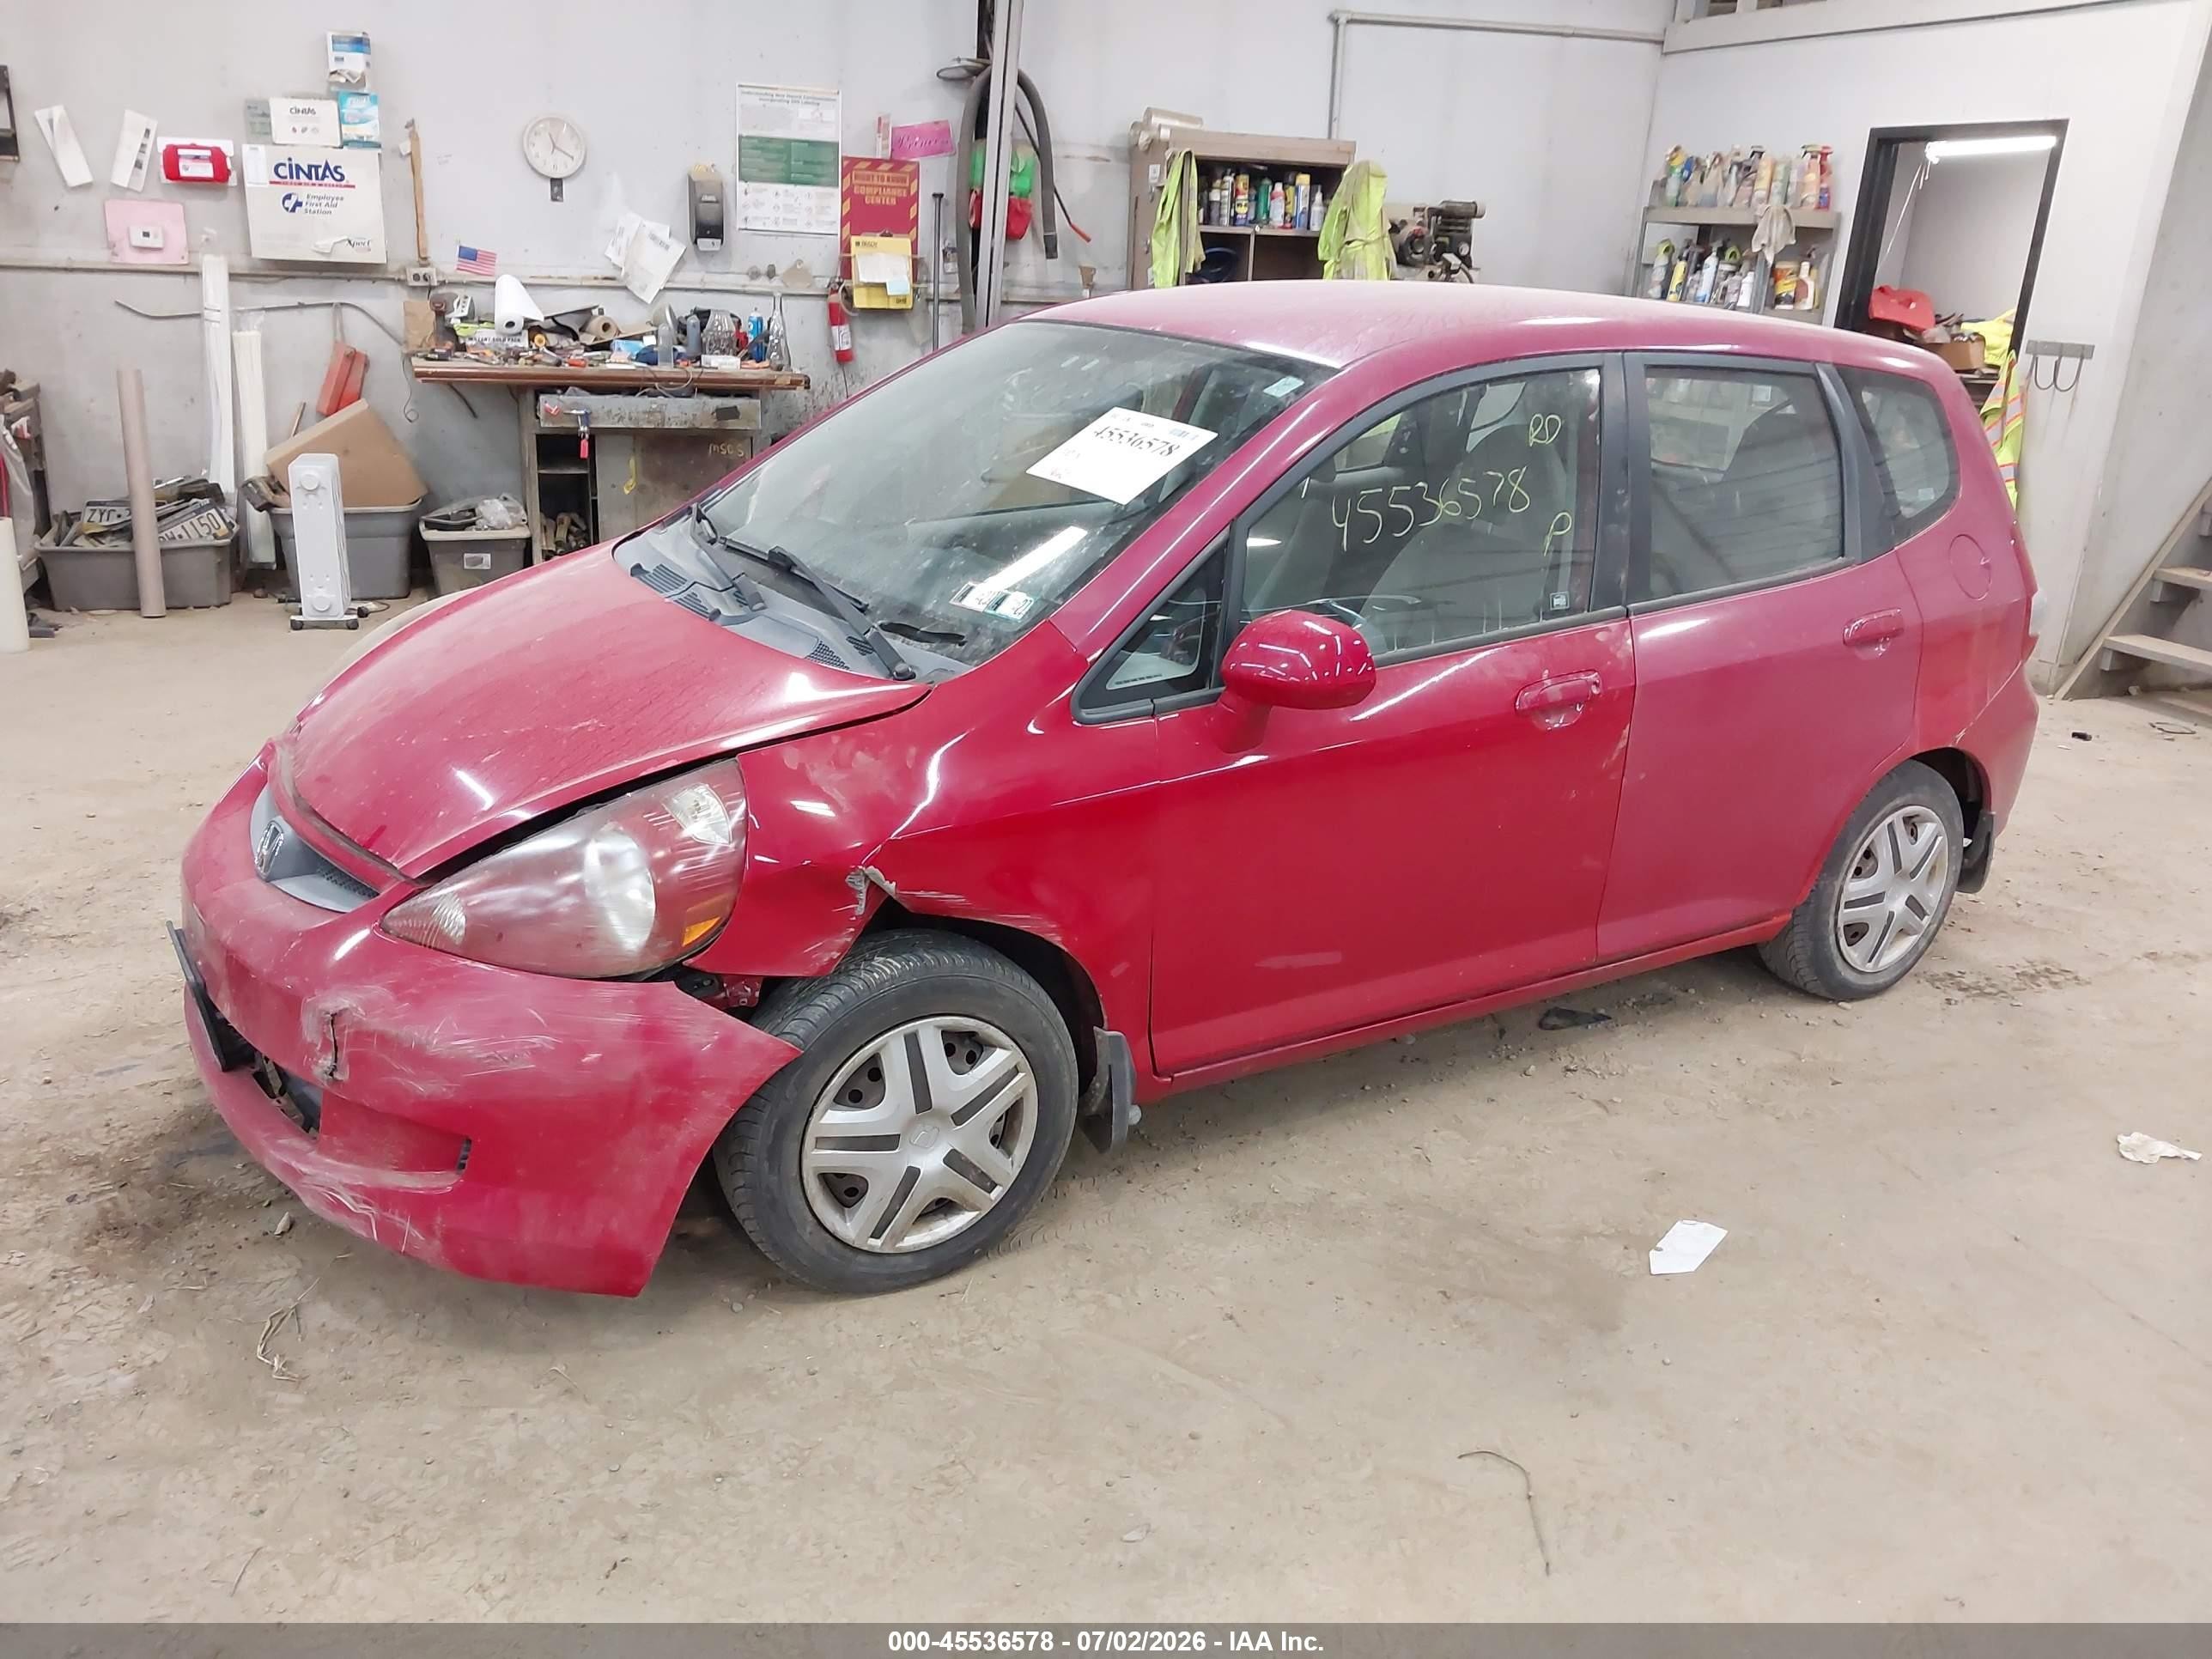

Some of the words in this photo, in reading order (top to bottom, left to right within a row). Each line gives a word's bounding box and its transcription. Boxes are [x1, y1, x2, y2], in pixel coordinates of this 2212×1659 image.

[306, 193, 344, 202] Employee
[865, 196, 896, 205] CENTER
[1094, 426, 1181, 457] 45536578
[1332, 465, 1530, 552] 45536578
